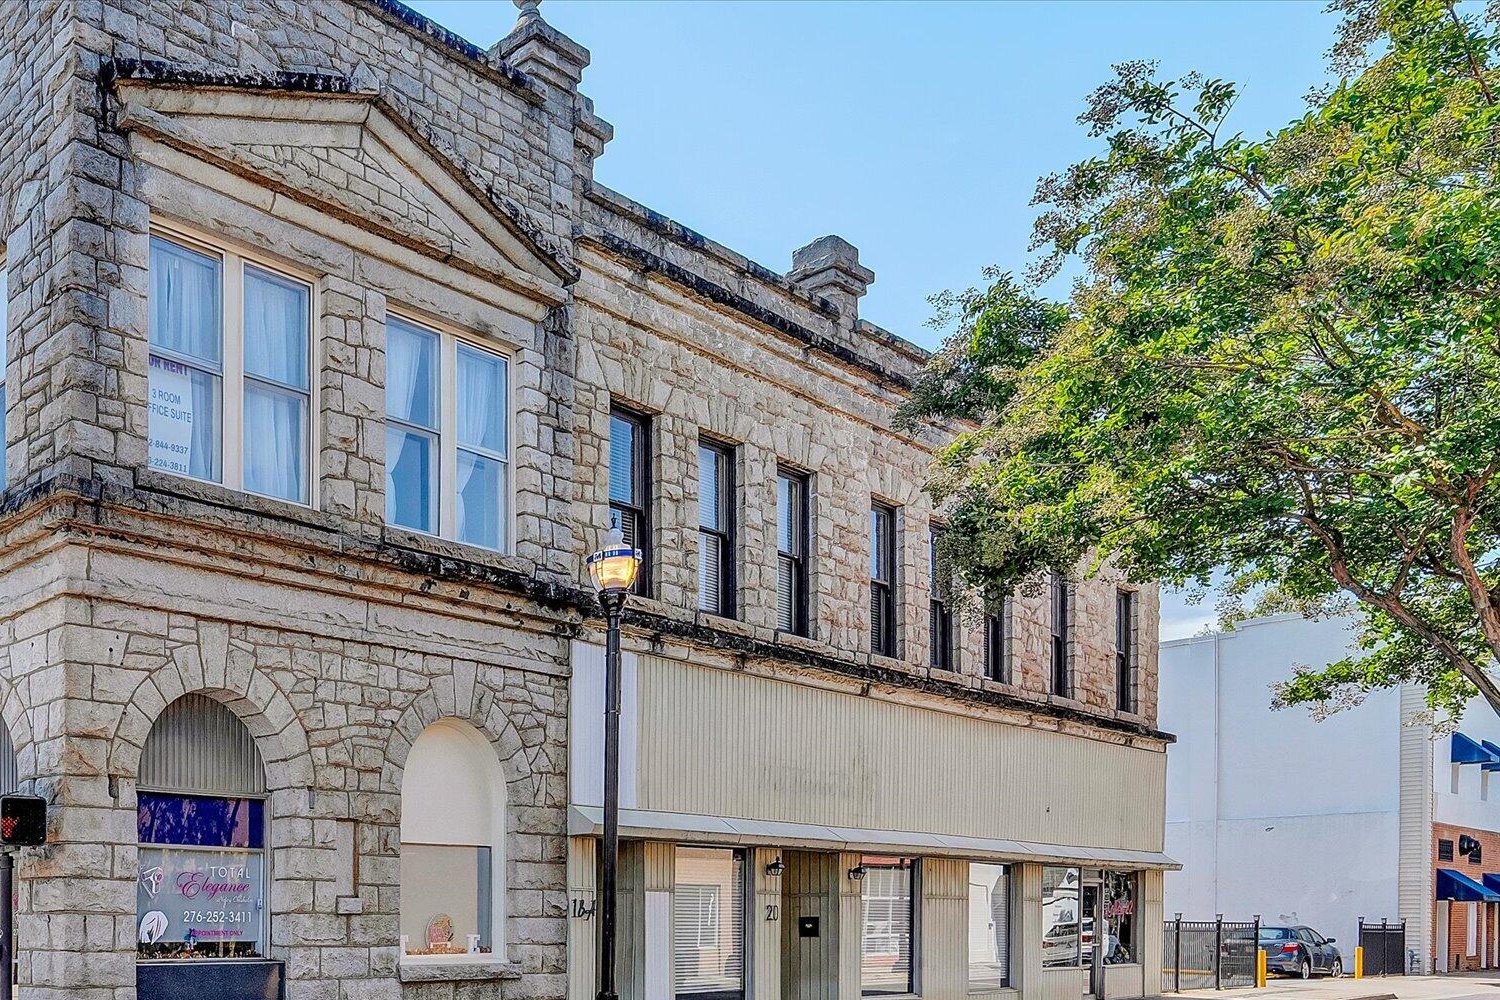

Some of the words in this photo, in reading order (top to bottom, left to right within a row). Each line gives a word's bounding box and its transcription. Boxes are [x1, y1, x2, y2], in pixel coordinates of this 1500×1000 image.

[152, 388, 157, 398] 3
[158, 390, 181, 404] ROOM
[170, 408, 192, 423] SUITE
[210, 865, 251, 879] TOTAL
[176, 871, 250, 900] Elegance
[183, 910, 252, 923] 276-252-3411
[765, 904, 779, 922] 20
